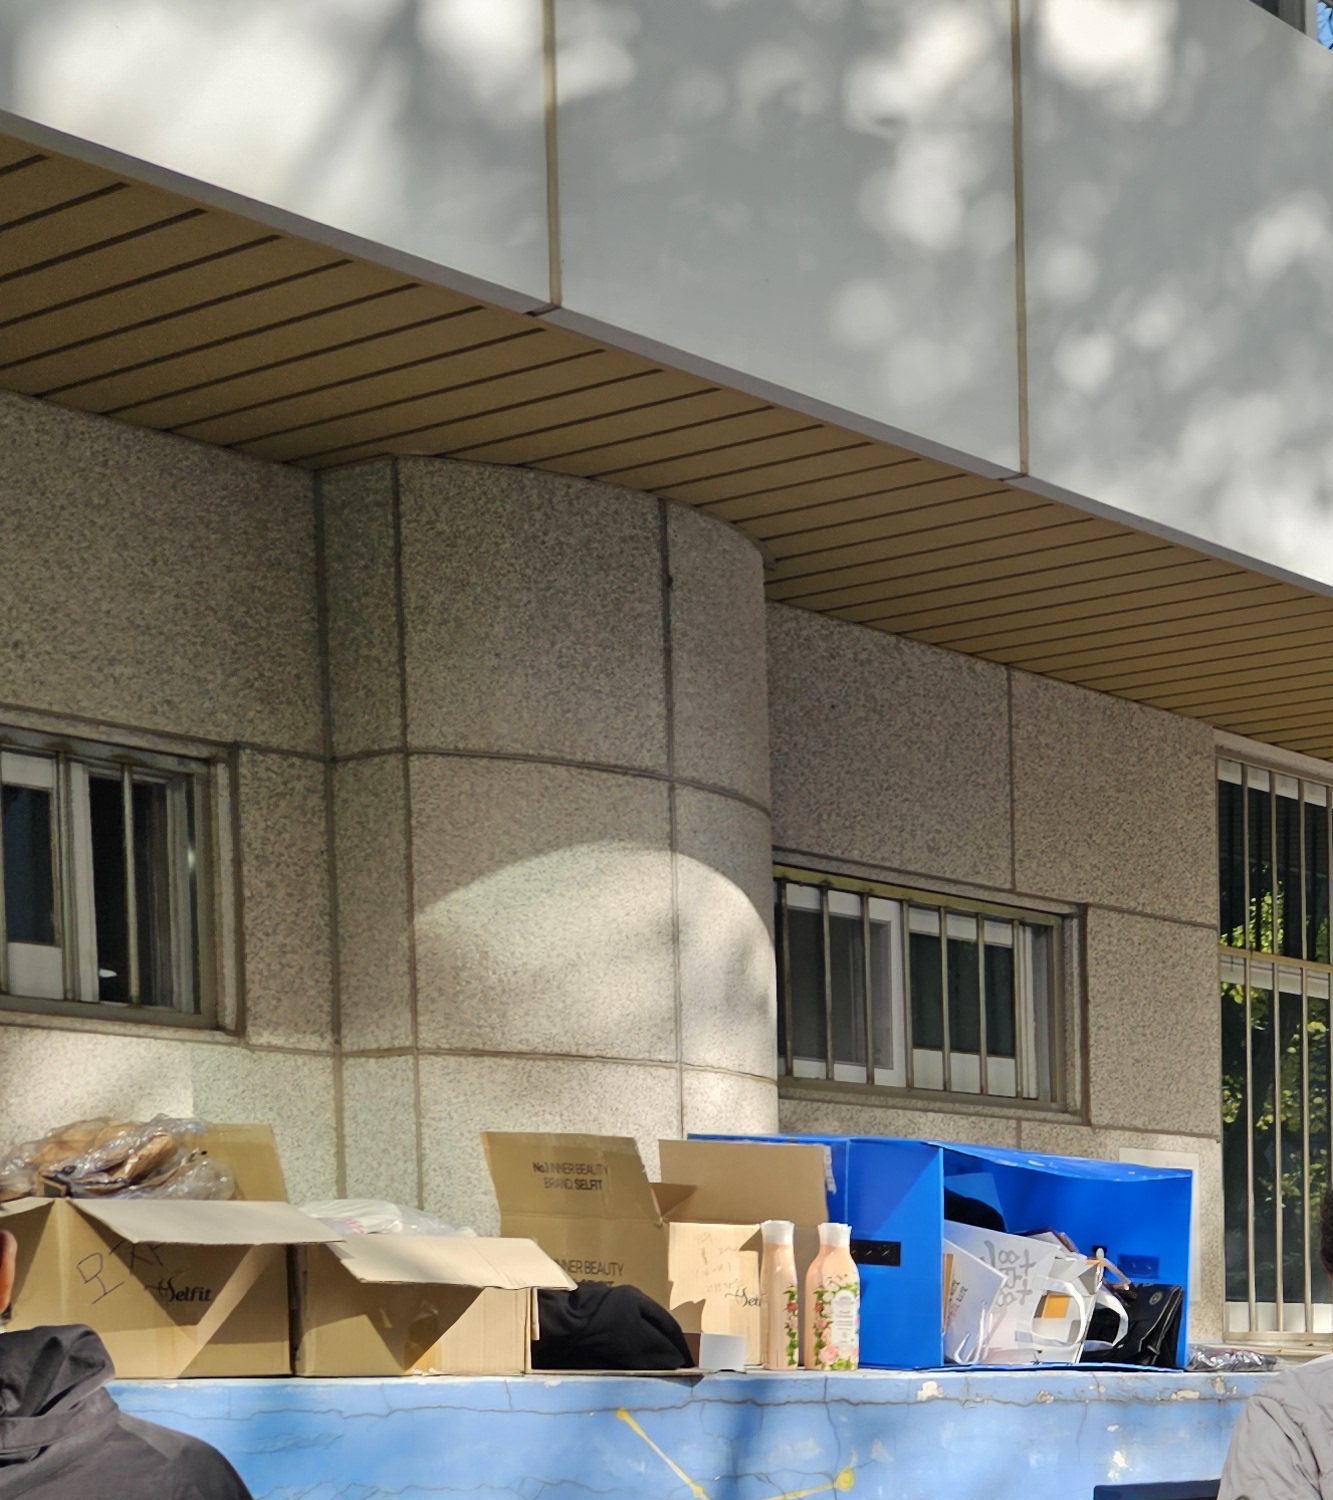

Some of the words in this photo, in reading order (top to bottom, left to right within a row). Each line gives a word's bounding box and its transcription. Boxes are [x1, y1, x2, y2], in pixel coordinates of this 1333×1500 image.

[575, 1163, 608, 1175] BEAUTY
[574, 1178, 603, 1191] SELFIT
[585, 1261, 625, 1277] BEAUTY
